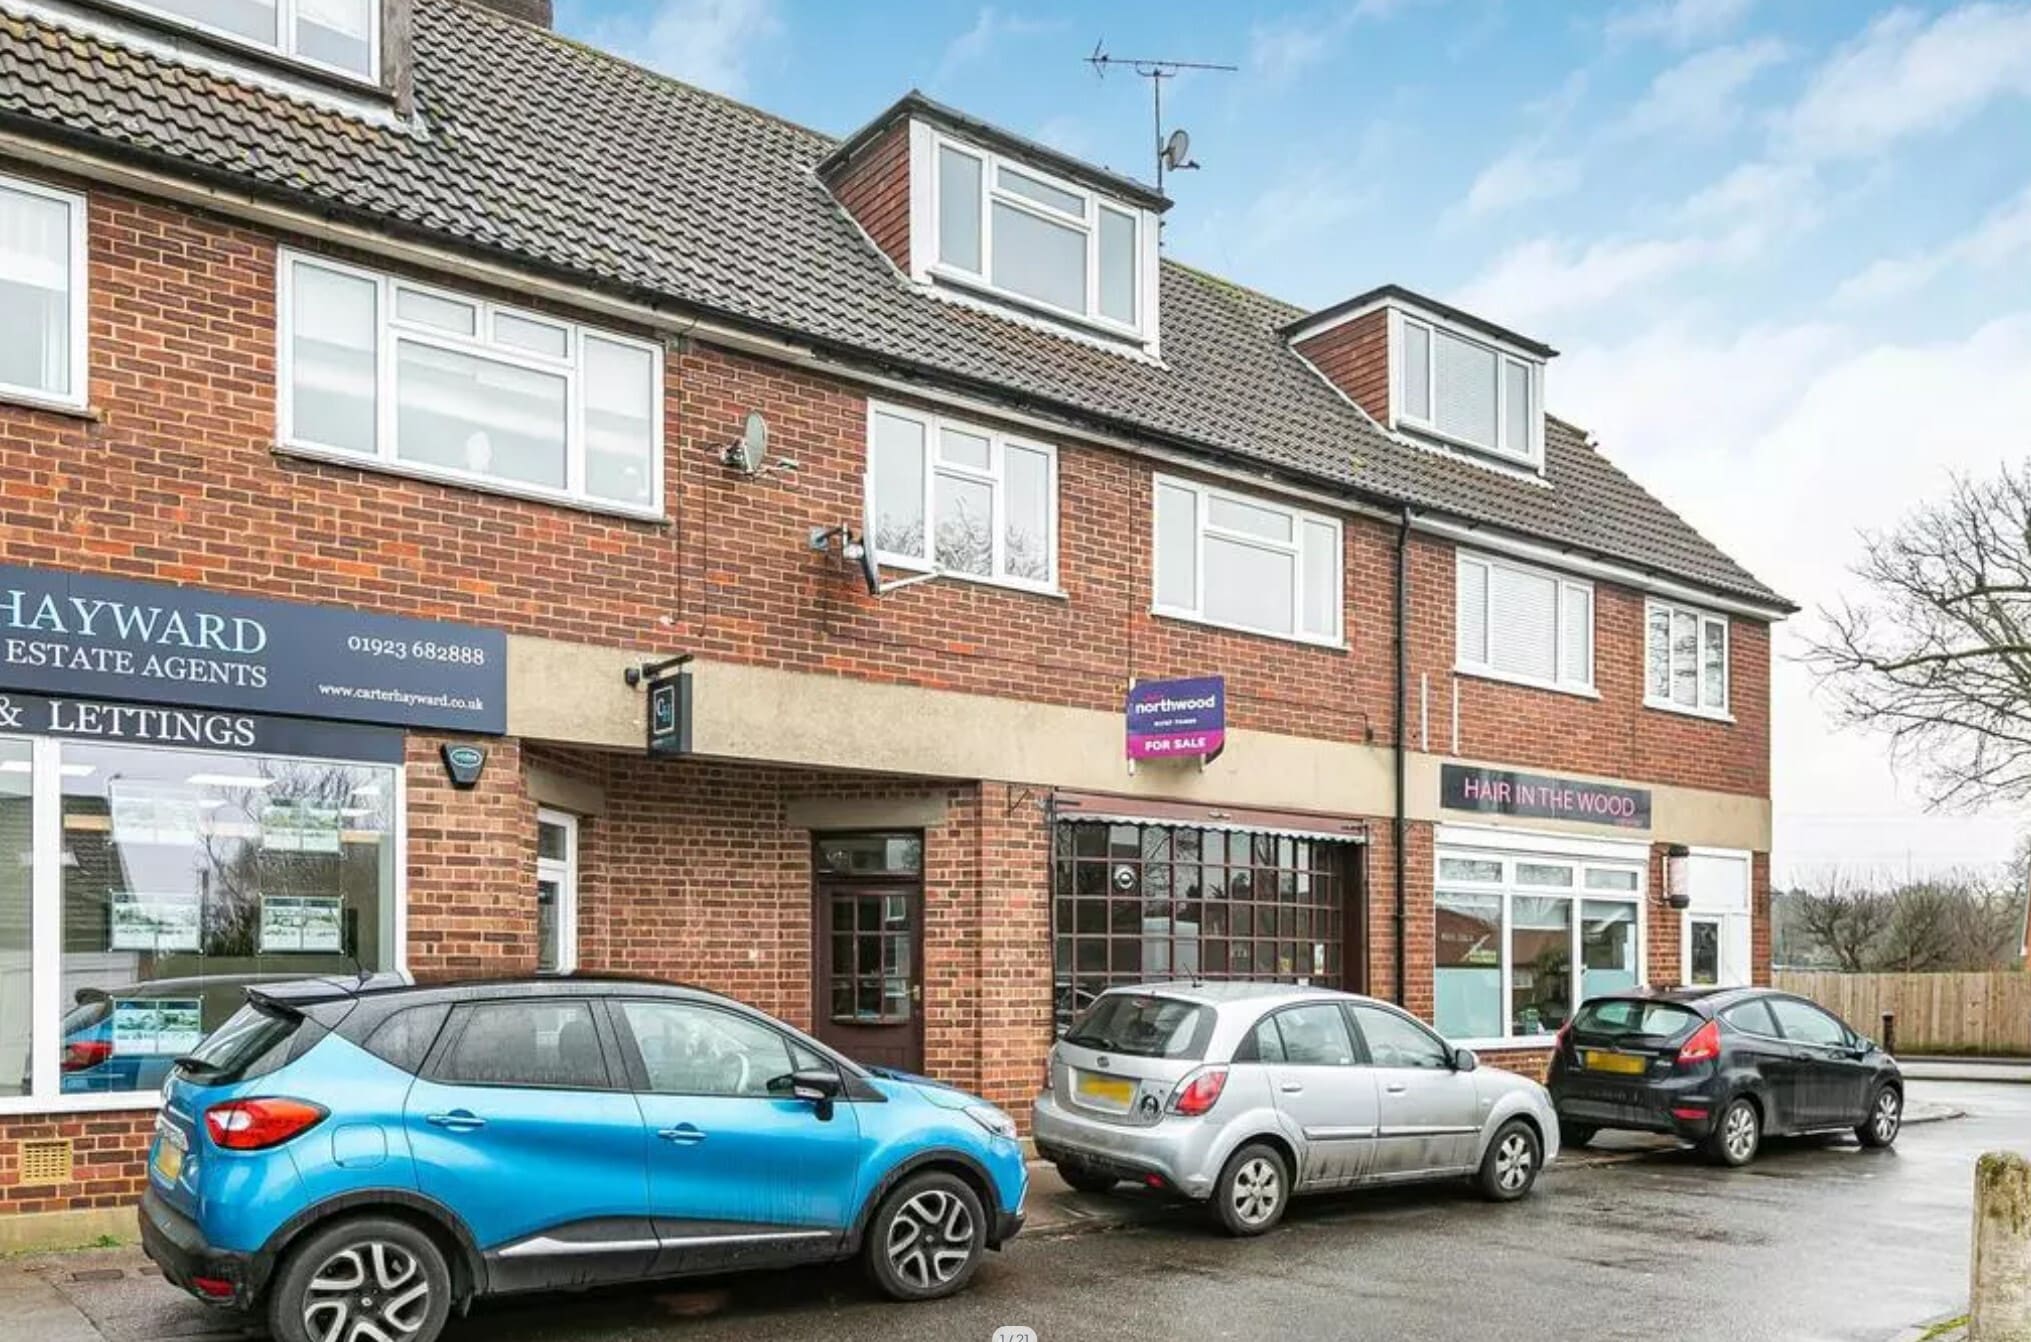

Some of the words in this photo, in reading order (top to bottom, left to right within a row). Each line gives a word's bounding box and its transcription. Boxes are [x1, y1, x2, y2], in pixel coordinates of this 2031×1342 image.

[0, 589, 268, 654] HAYWARD
[5, 638, 135, 675] ESTATE
[141, 655, 268, 689] AGENTS
[347, 635, 407, 660] 01923
[411, 640, 485, 666] 682888
[318, 683, 484, 711] www.carterhayward.co.uk
[1135, 694, 1215, 714] northwood
[48, 700, 256, 747] LETTINGS
[1144, 740, 1171, 752] FOR
[1174, 737, 1207, 749] SALE
[1464, 777, 1512, 802] HAIR
[1516, 785, 1535, 806] IN
[1538, 787, 1574, 811] THE
[1576, 791, 1635, 818] WOOD
